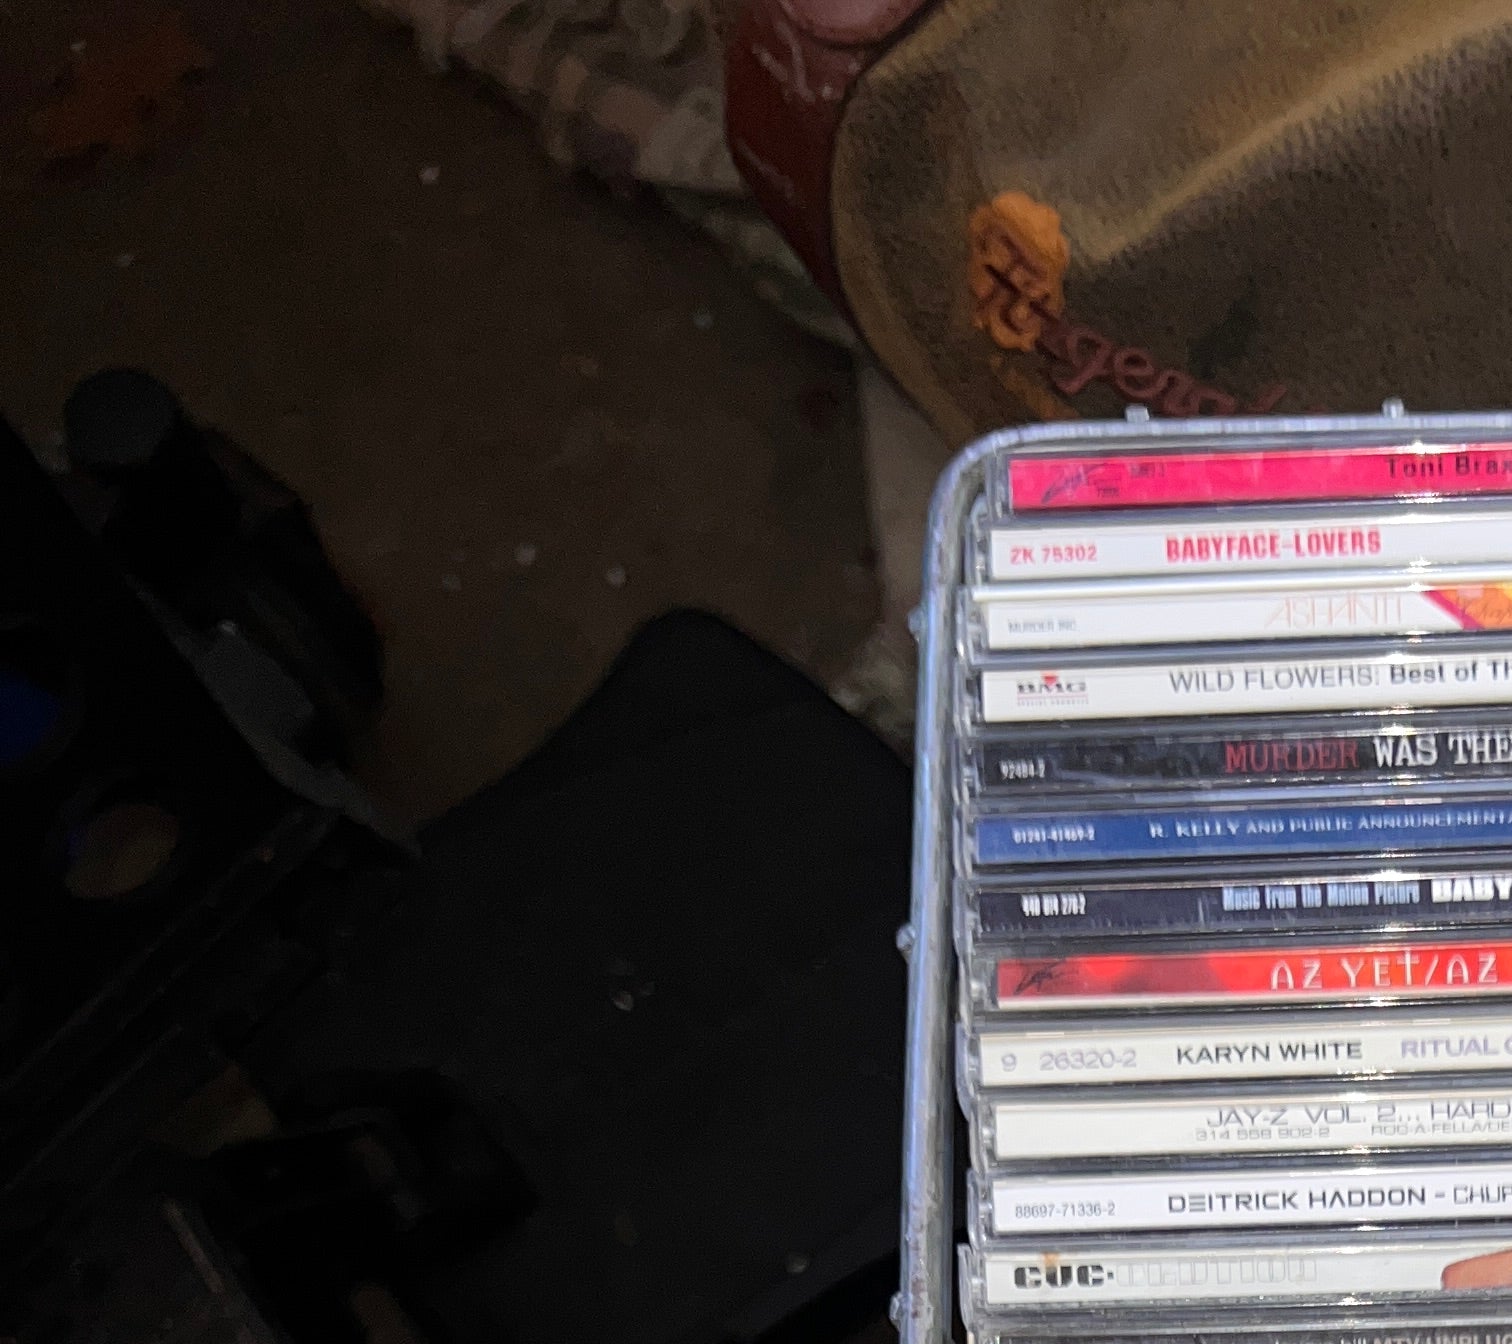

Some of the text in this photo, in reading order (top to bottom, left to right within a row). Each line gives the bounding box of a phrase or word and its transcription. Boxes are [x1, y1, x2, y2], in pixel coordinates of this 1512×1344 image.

[1388, 455, 1444, 478] Toni
[1165, 527, 1382, 563] BABYFACE-LOVERS
[1170, 670, 1234, 694] WILD
[1244, 667, 1381, 691] FLOWERS:
[1389, 664, 1447, 684] Best
[1455, 658, 1479, 682] of
[1225, 740, 1359, 774] MURDER
[1373, 734, 1439, 768] WAS
[1176, 1043, 1271, 1065] KARYN
[1280, 1041, 1363, 1061] WHITE
[1400, 1036, 1500, 1058] RITUAL
[1015, 1203, 1116, 1219] 88697-71336-2
